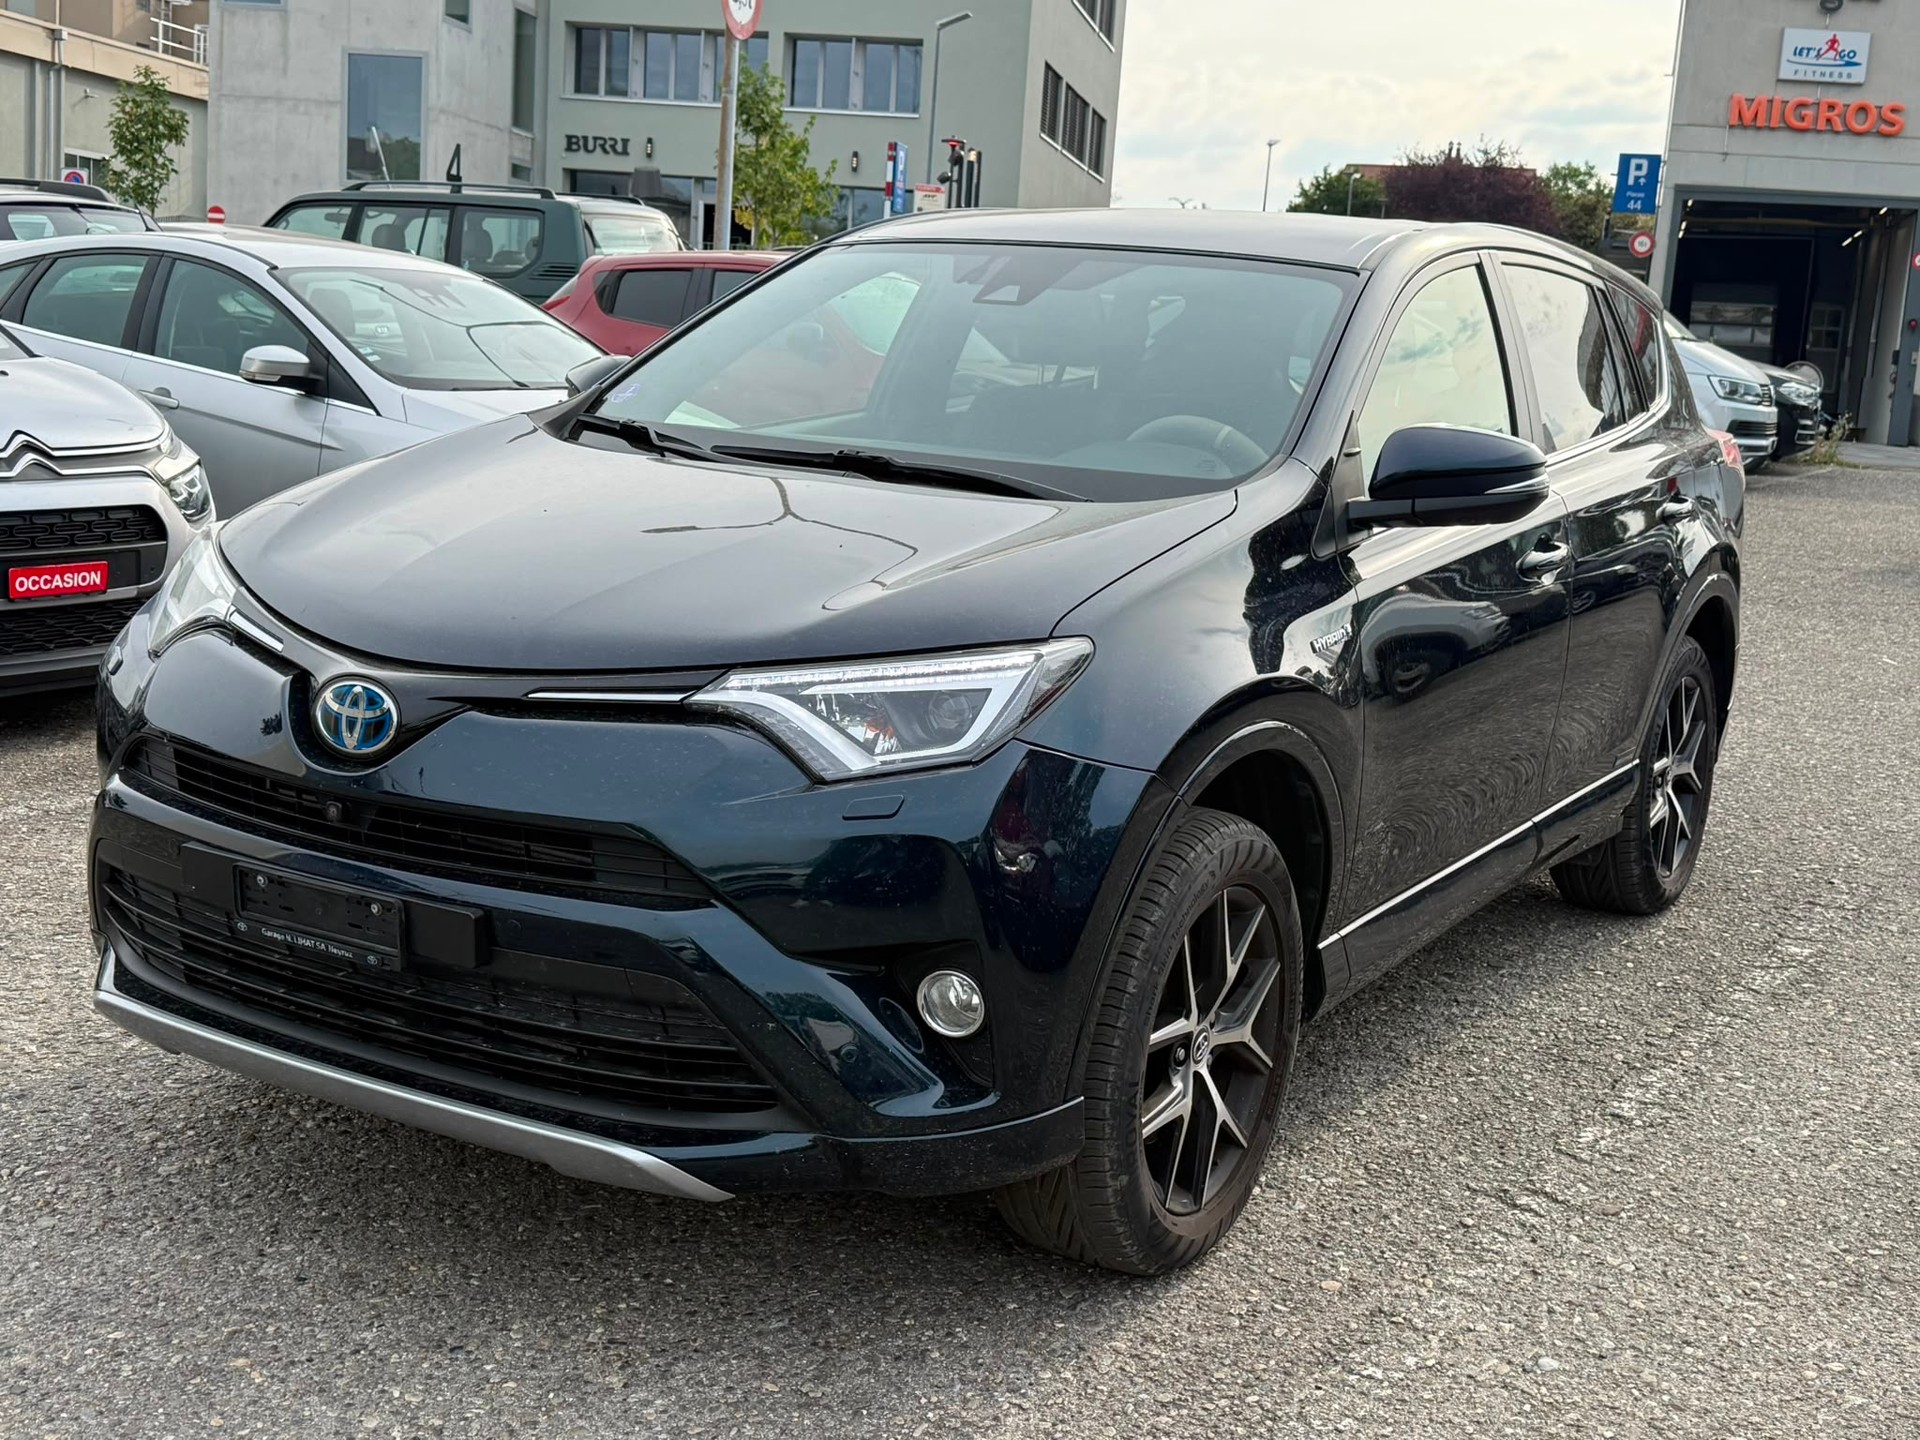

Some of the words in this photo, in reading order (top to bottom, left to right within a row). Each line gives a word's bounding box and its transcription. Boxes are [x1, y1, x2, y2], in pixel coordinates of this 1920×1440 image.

[1793, 46, 1822, 59] LET'S
[1838, 49, 1857, 60] GO
[1793, 69, 1852, 79] FITNESS
[1728, 93, 1906, 136] MIGROS
[564, 134, 630, 156] BURRI
[1627, 158, 1649, 186] P
[1627, 199, 1642, 211] 44
[15, 570, 101, 592] OCCASION
[1312, 626, 1348, 654] HYBRID
[261, 927, 285, 941] Garage
[315, 942, 327, 952] SA
